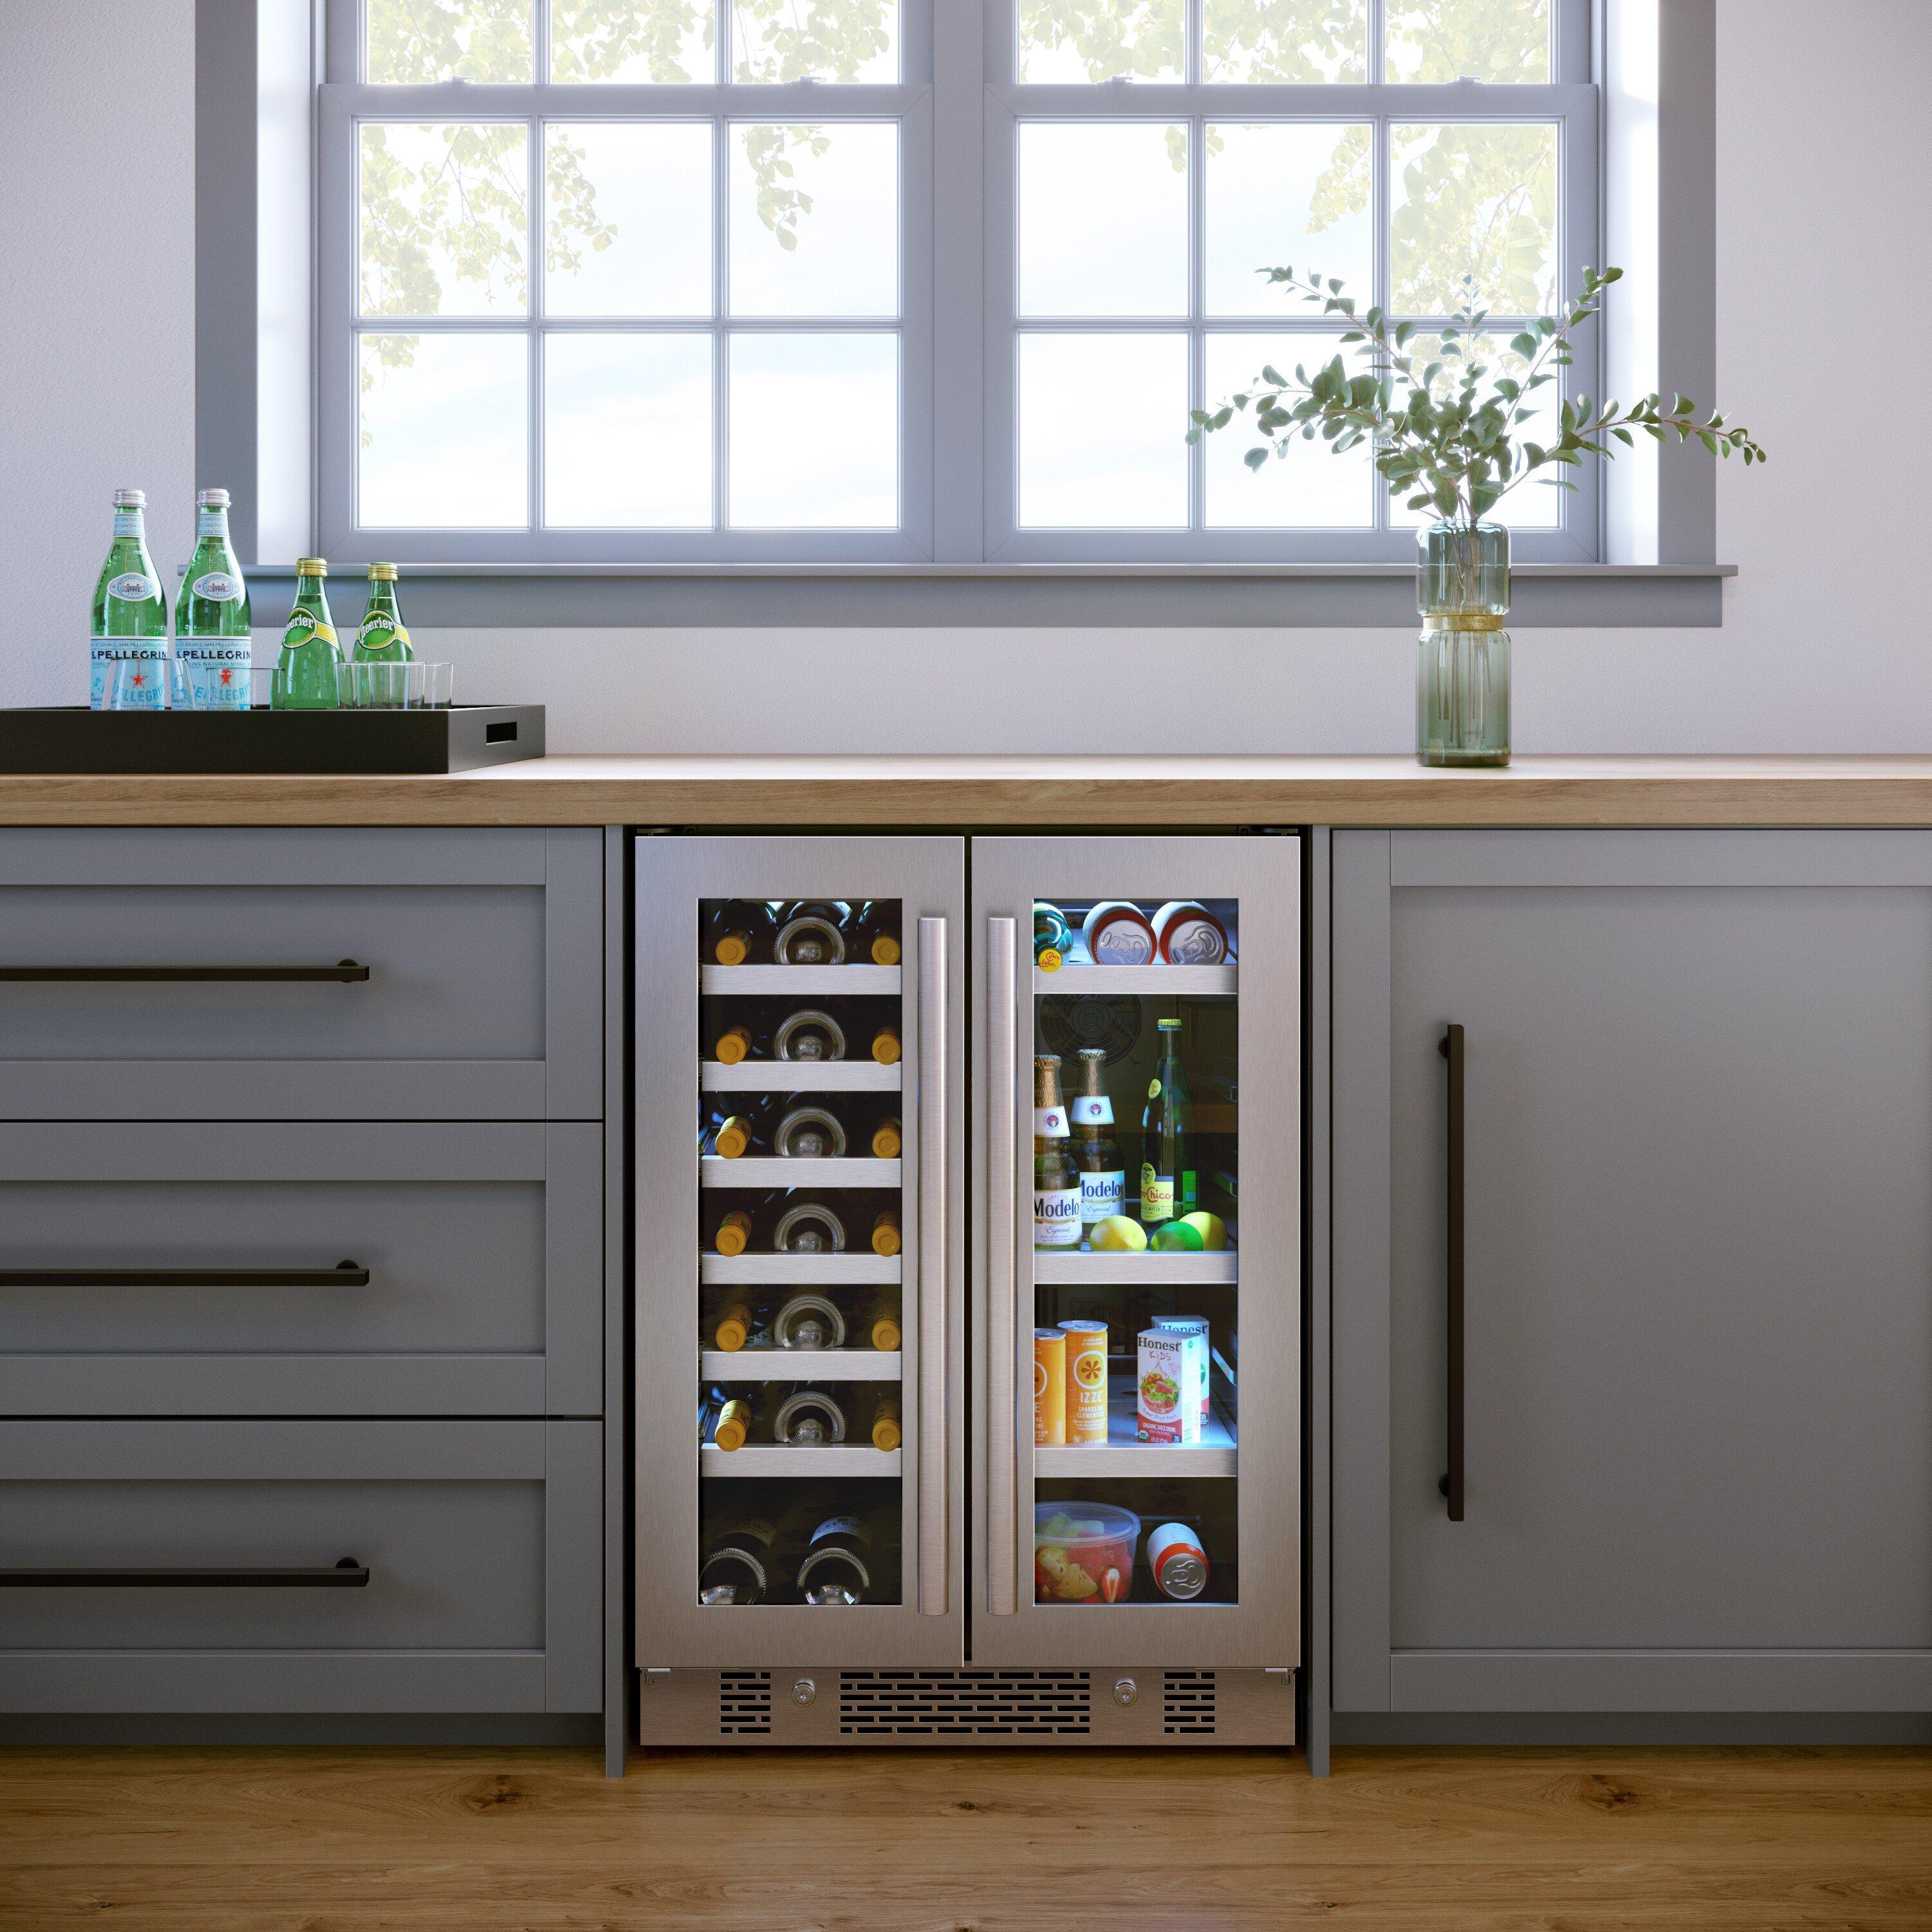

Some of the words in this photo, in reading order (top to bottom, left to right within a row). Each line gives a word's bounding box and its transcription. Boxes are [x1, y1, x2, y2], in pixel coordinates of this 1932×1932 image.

[91, 650, 167, 659] S.PELLEGRIN
[176, 650, 251, 659] S.PELLEGRIN
[1034, 1198, 1079, 1217] Modelo
[1137, 1336, 1181, 1352] Honest
